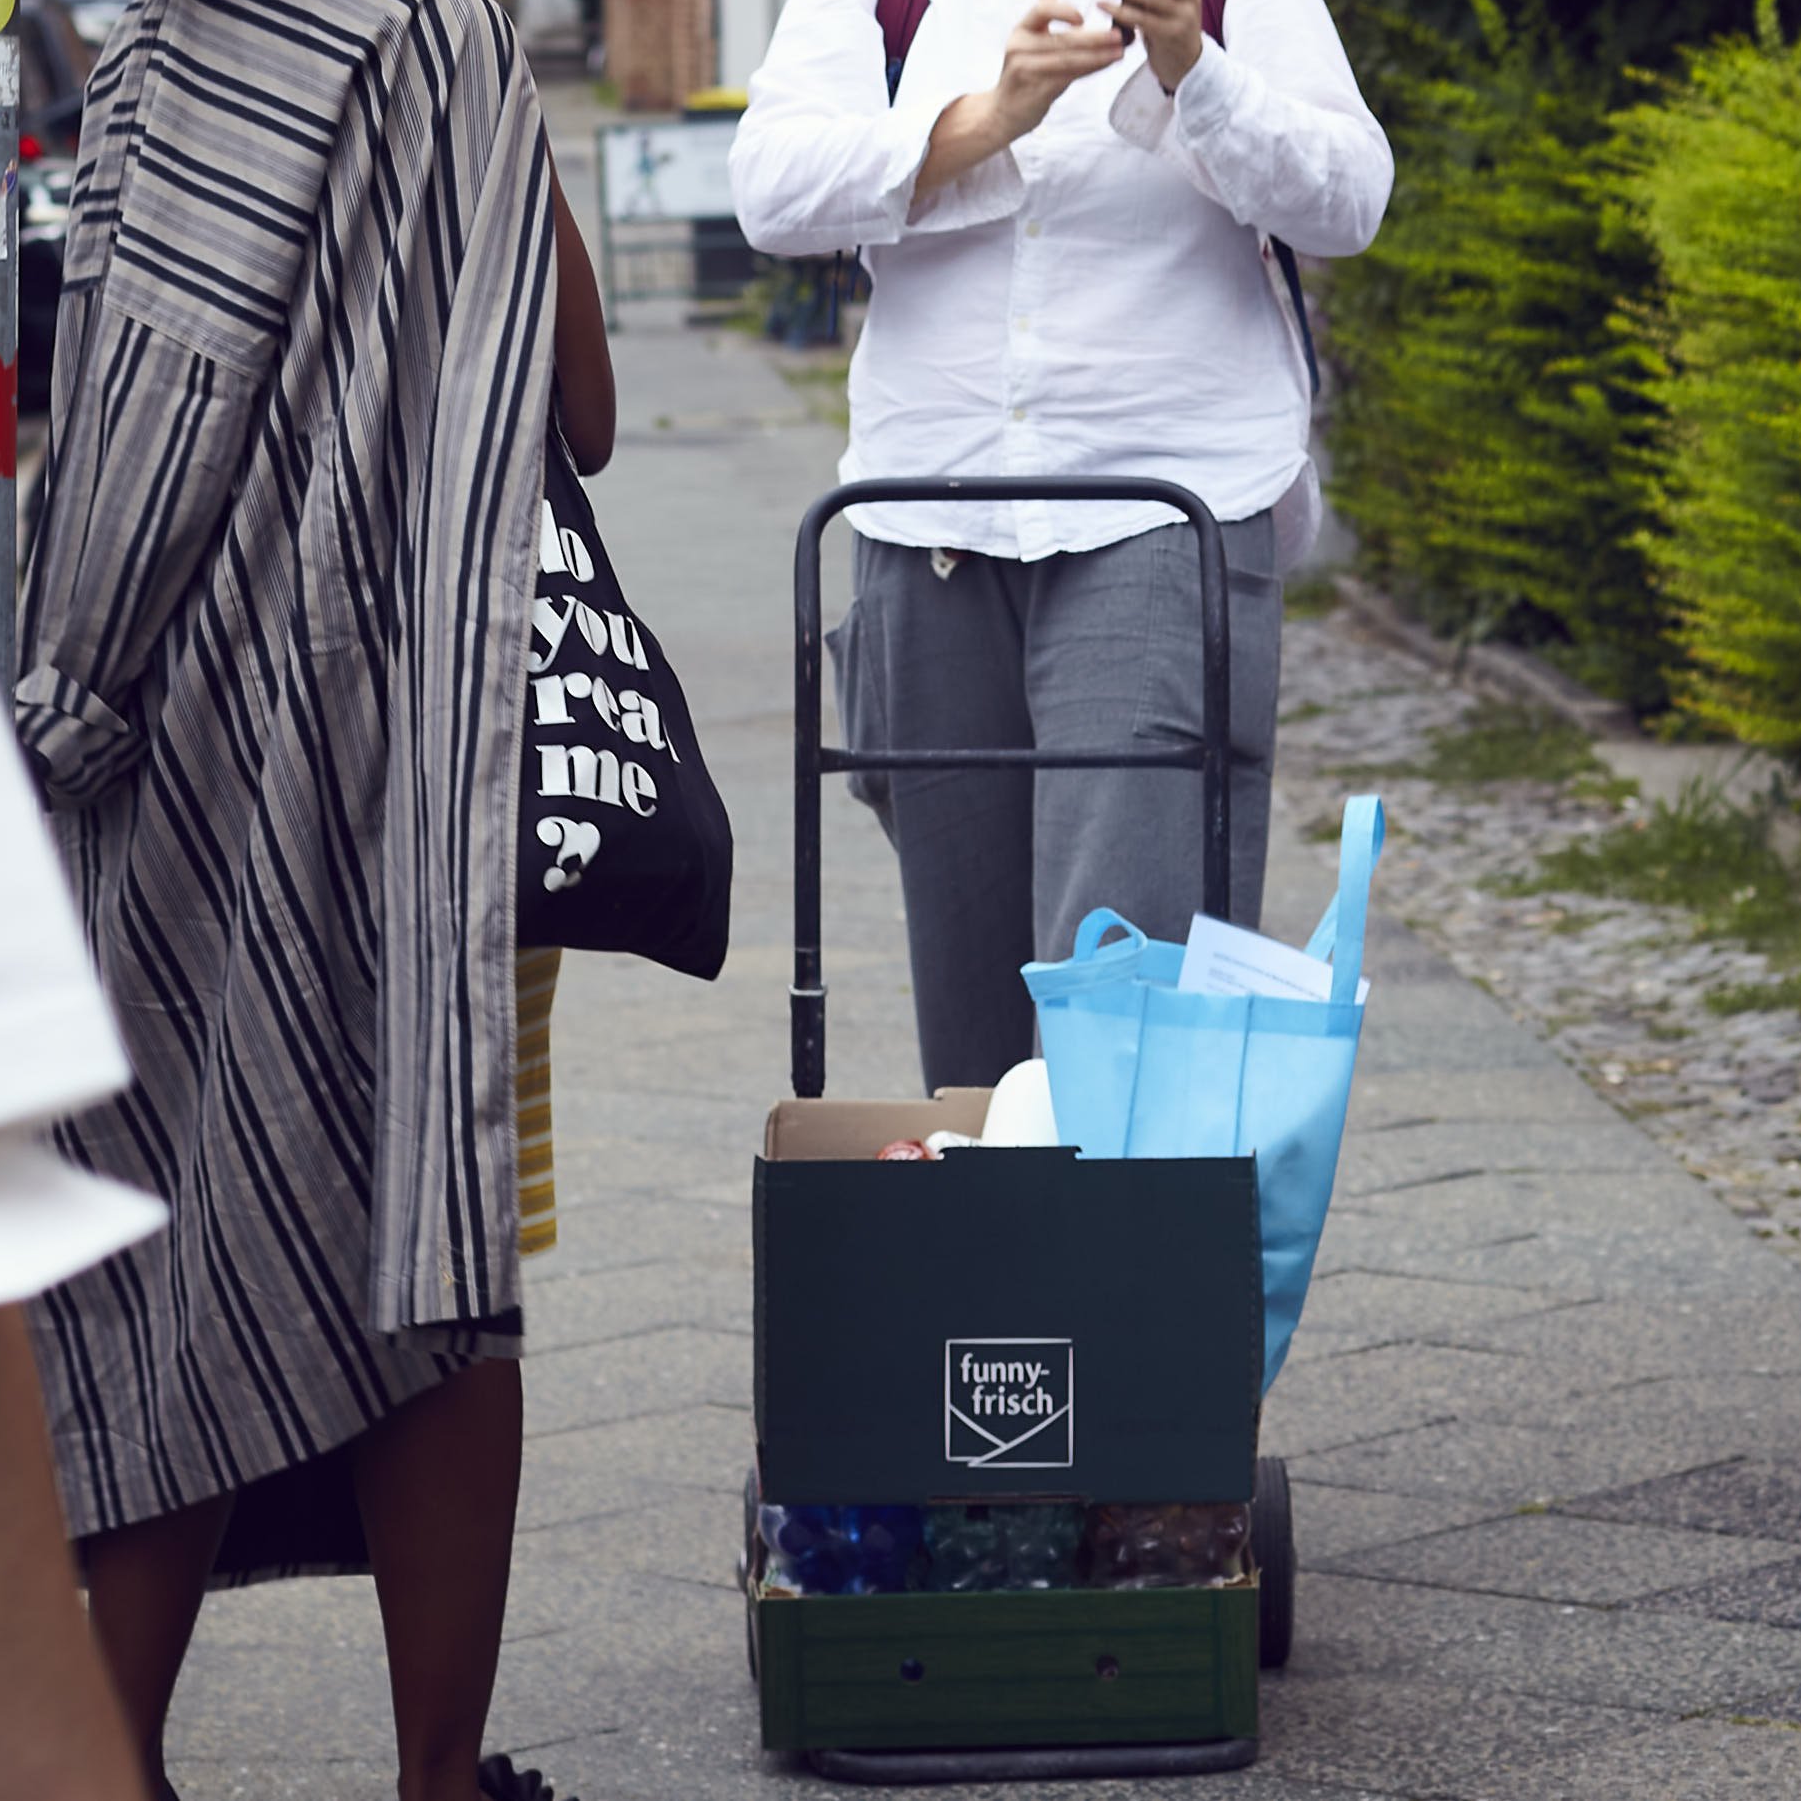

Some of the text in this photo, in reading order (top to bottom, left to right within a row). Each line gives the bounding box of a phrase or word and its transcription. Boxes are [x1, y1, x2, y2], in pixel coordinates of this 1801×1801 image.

[527, 595, 650, 673] you
[535, 745, 658, 817] me
[536, 816, 601, 892] ?
[960, 1352, 1050, 1389] funny-
[972, 1385, 1054, 1415] frisch
